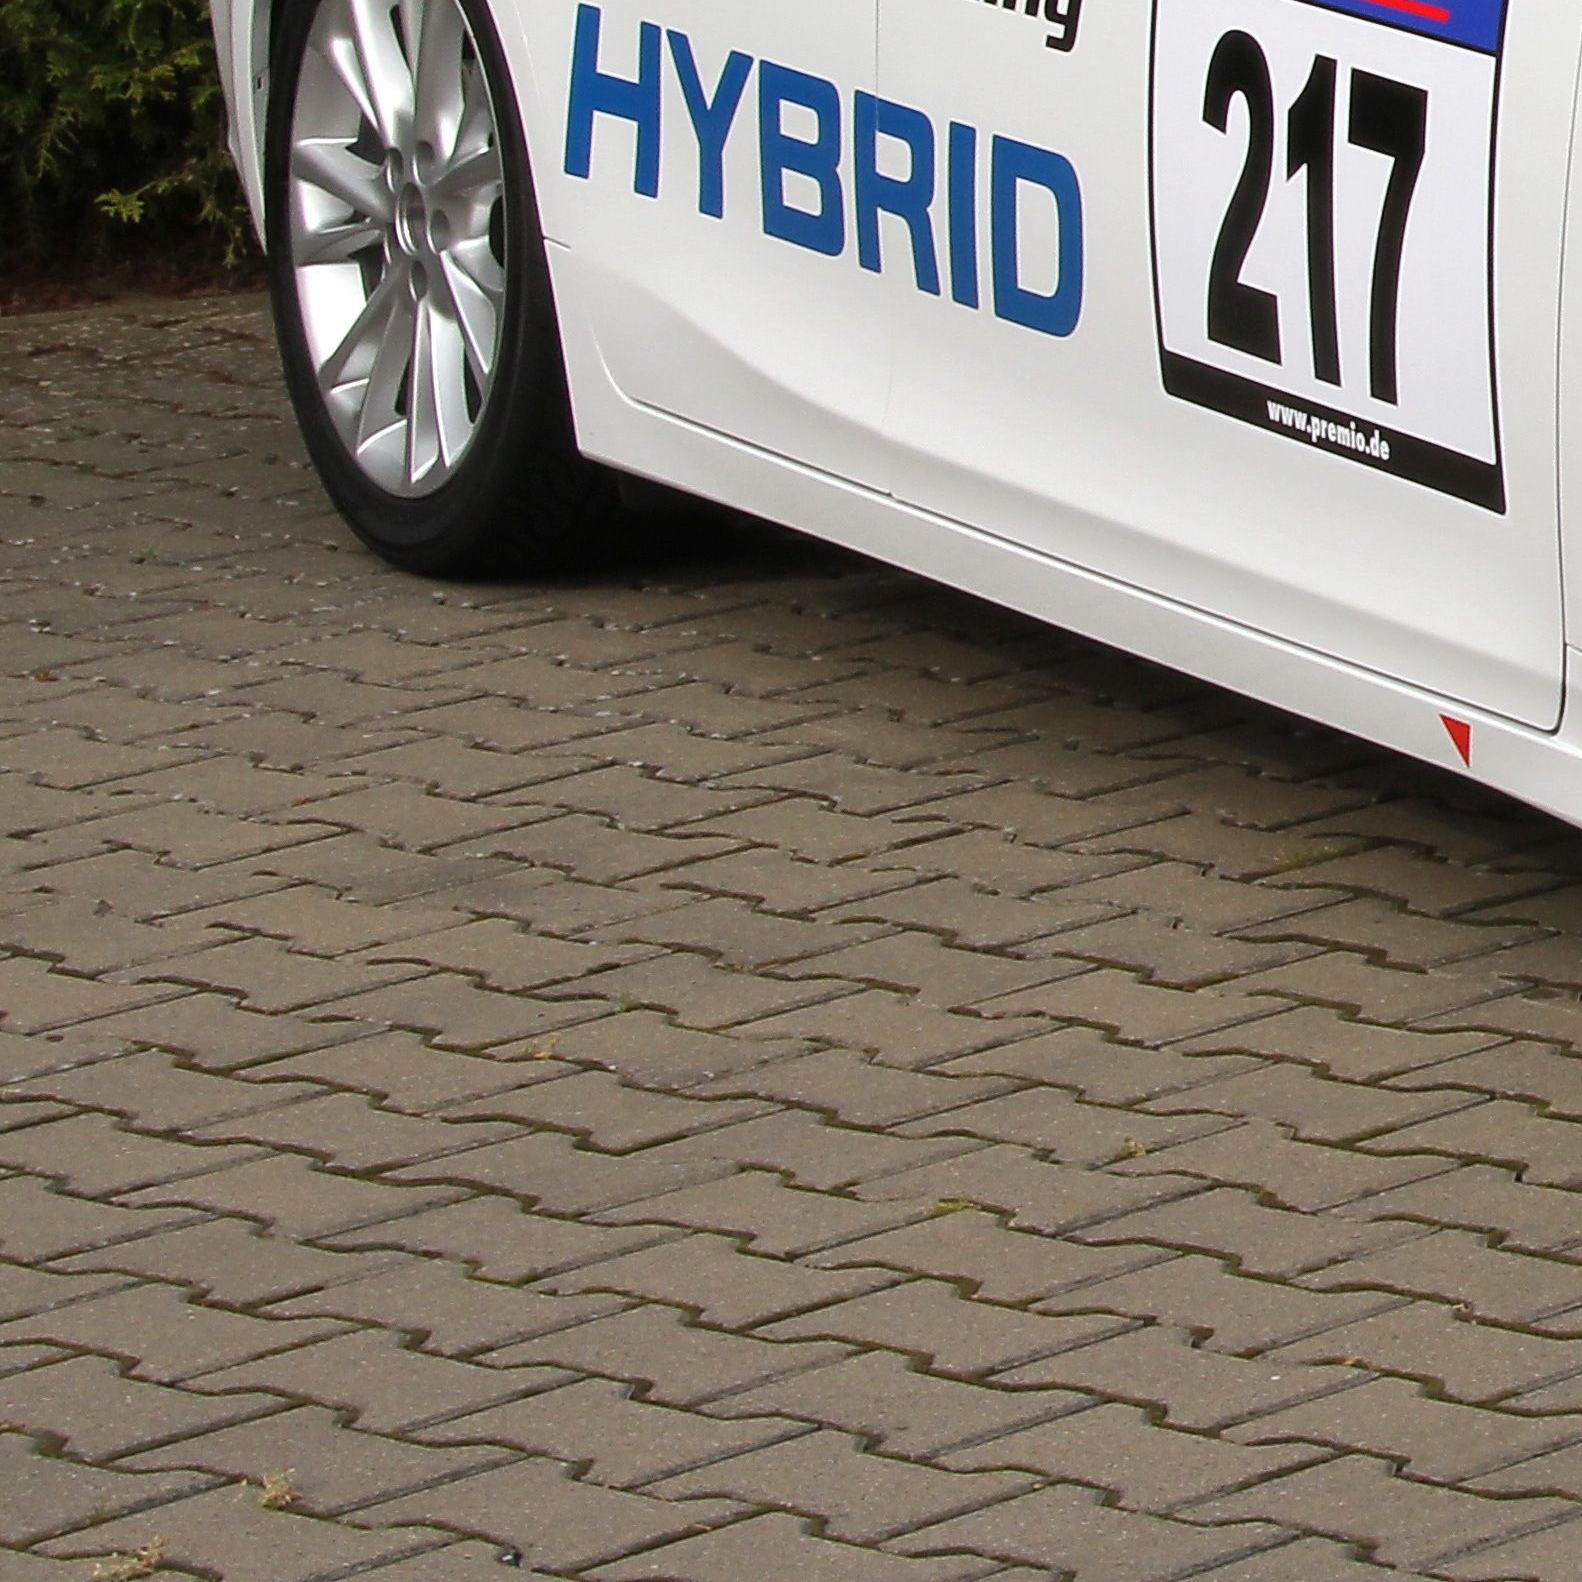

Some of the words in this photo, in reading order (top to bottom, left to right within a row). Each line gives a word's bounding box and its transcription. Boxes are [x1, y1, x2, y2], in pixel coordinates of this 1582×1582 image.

[563, 2, 1084, 338] HYBRID
[1202, 28, 1429, 407] 217
[1265, 396, 1392, 462] www.premio.de
